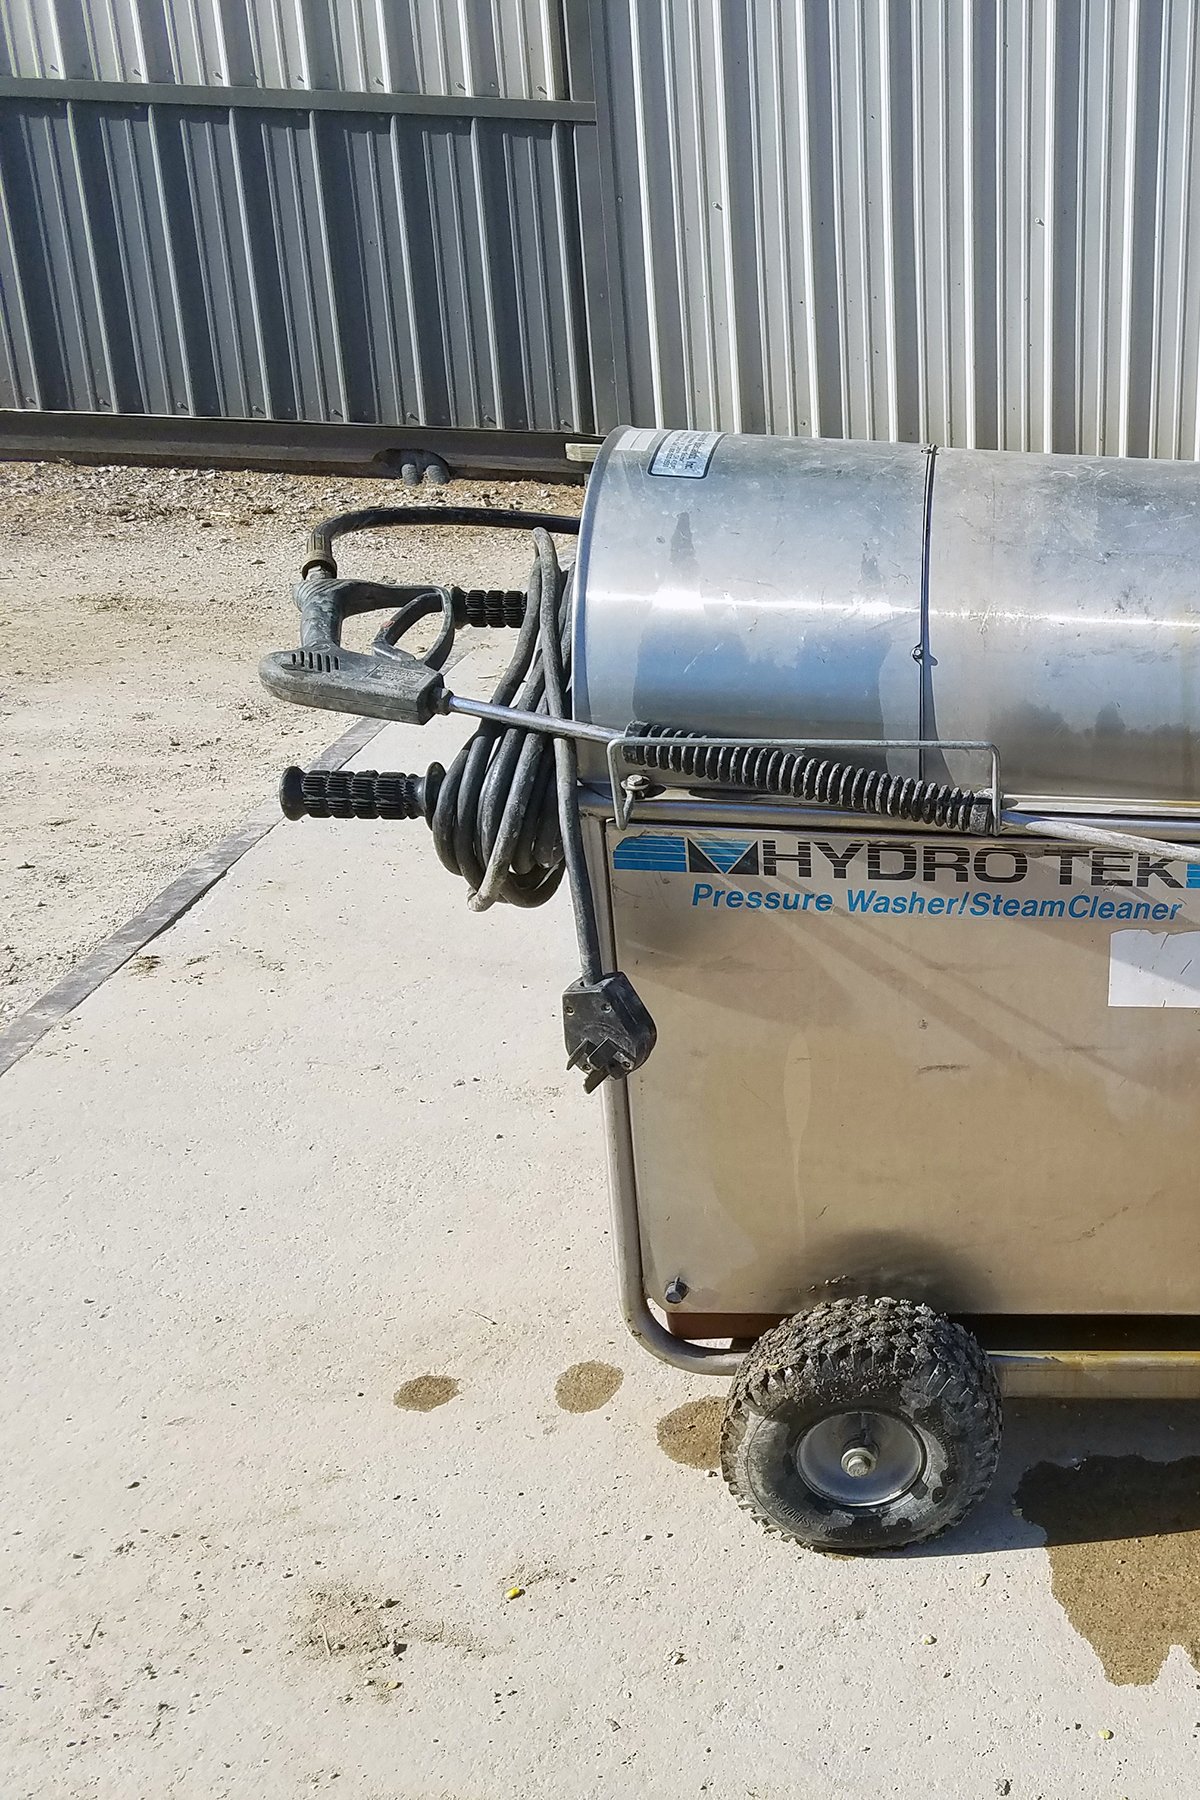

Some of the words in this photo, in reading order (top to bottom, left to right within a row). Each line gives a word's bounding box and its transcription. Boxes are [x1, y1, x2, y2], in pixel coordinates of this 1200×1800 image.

[762, 839, 1028, 884] HYDRO
[1044, 849, 1186, 889] TEK
[692, 883, 833, 912] Pressure
